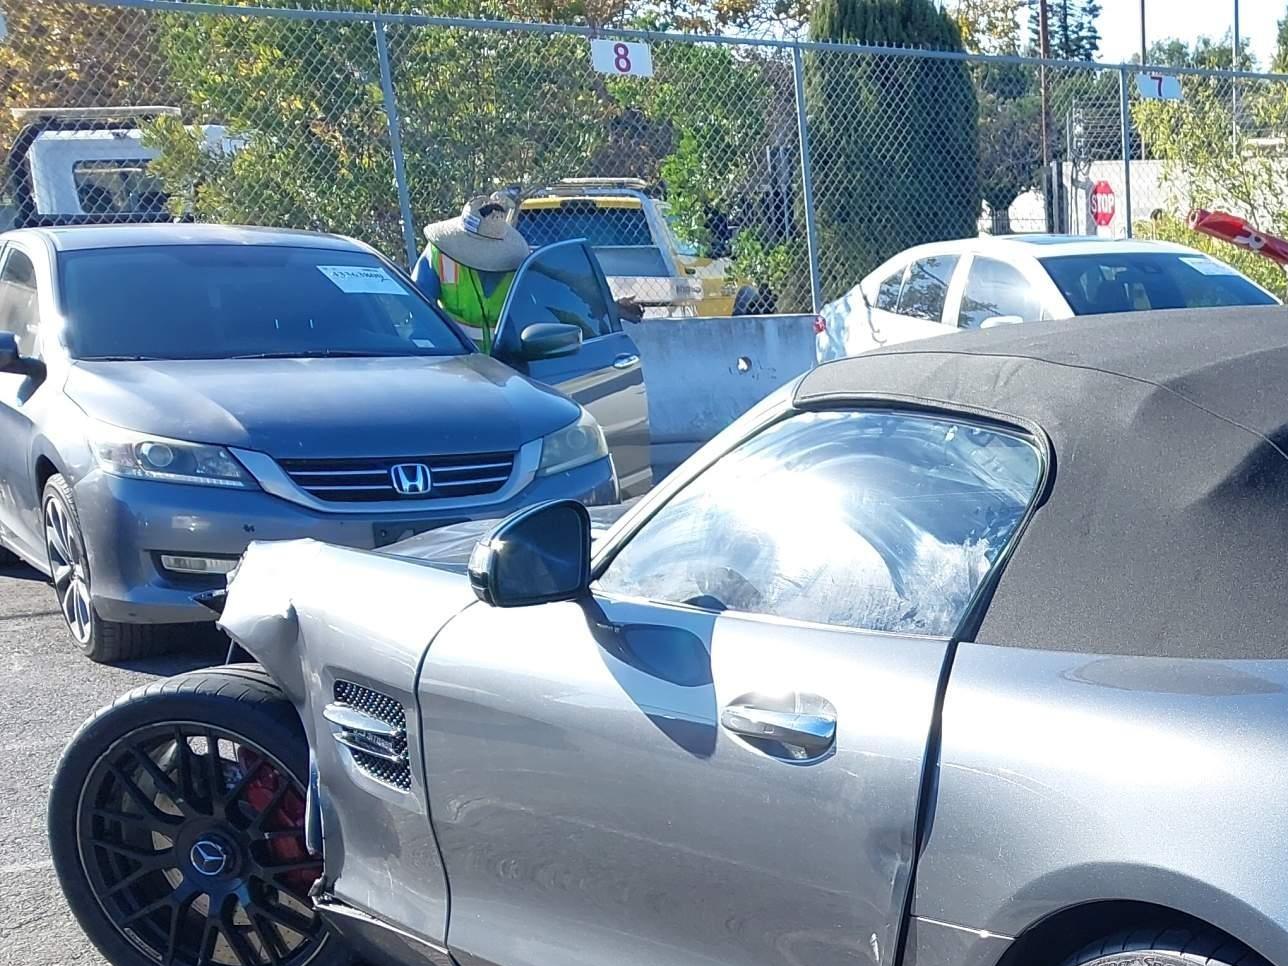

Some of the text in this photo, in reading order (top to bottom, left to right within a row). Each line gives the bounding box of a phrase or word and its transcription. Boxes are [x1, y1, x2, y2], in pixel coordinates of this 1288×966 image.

[613, 43, 631, 72] 8
[1150, 76, 1163, 97] 7
[1091, 193, 1115, 214] STOP
